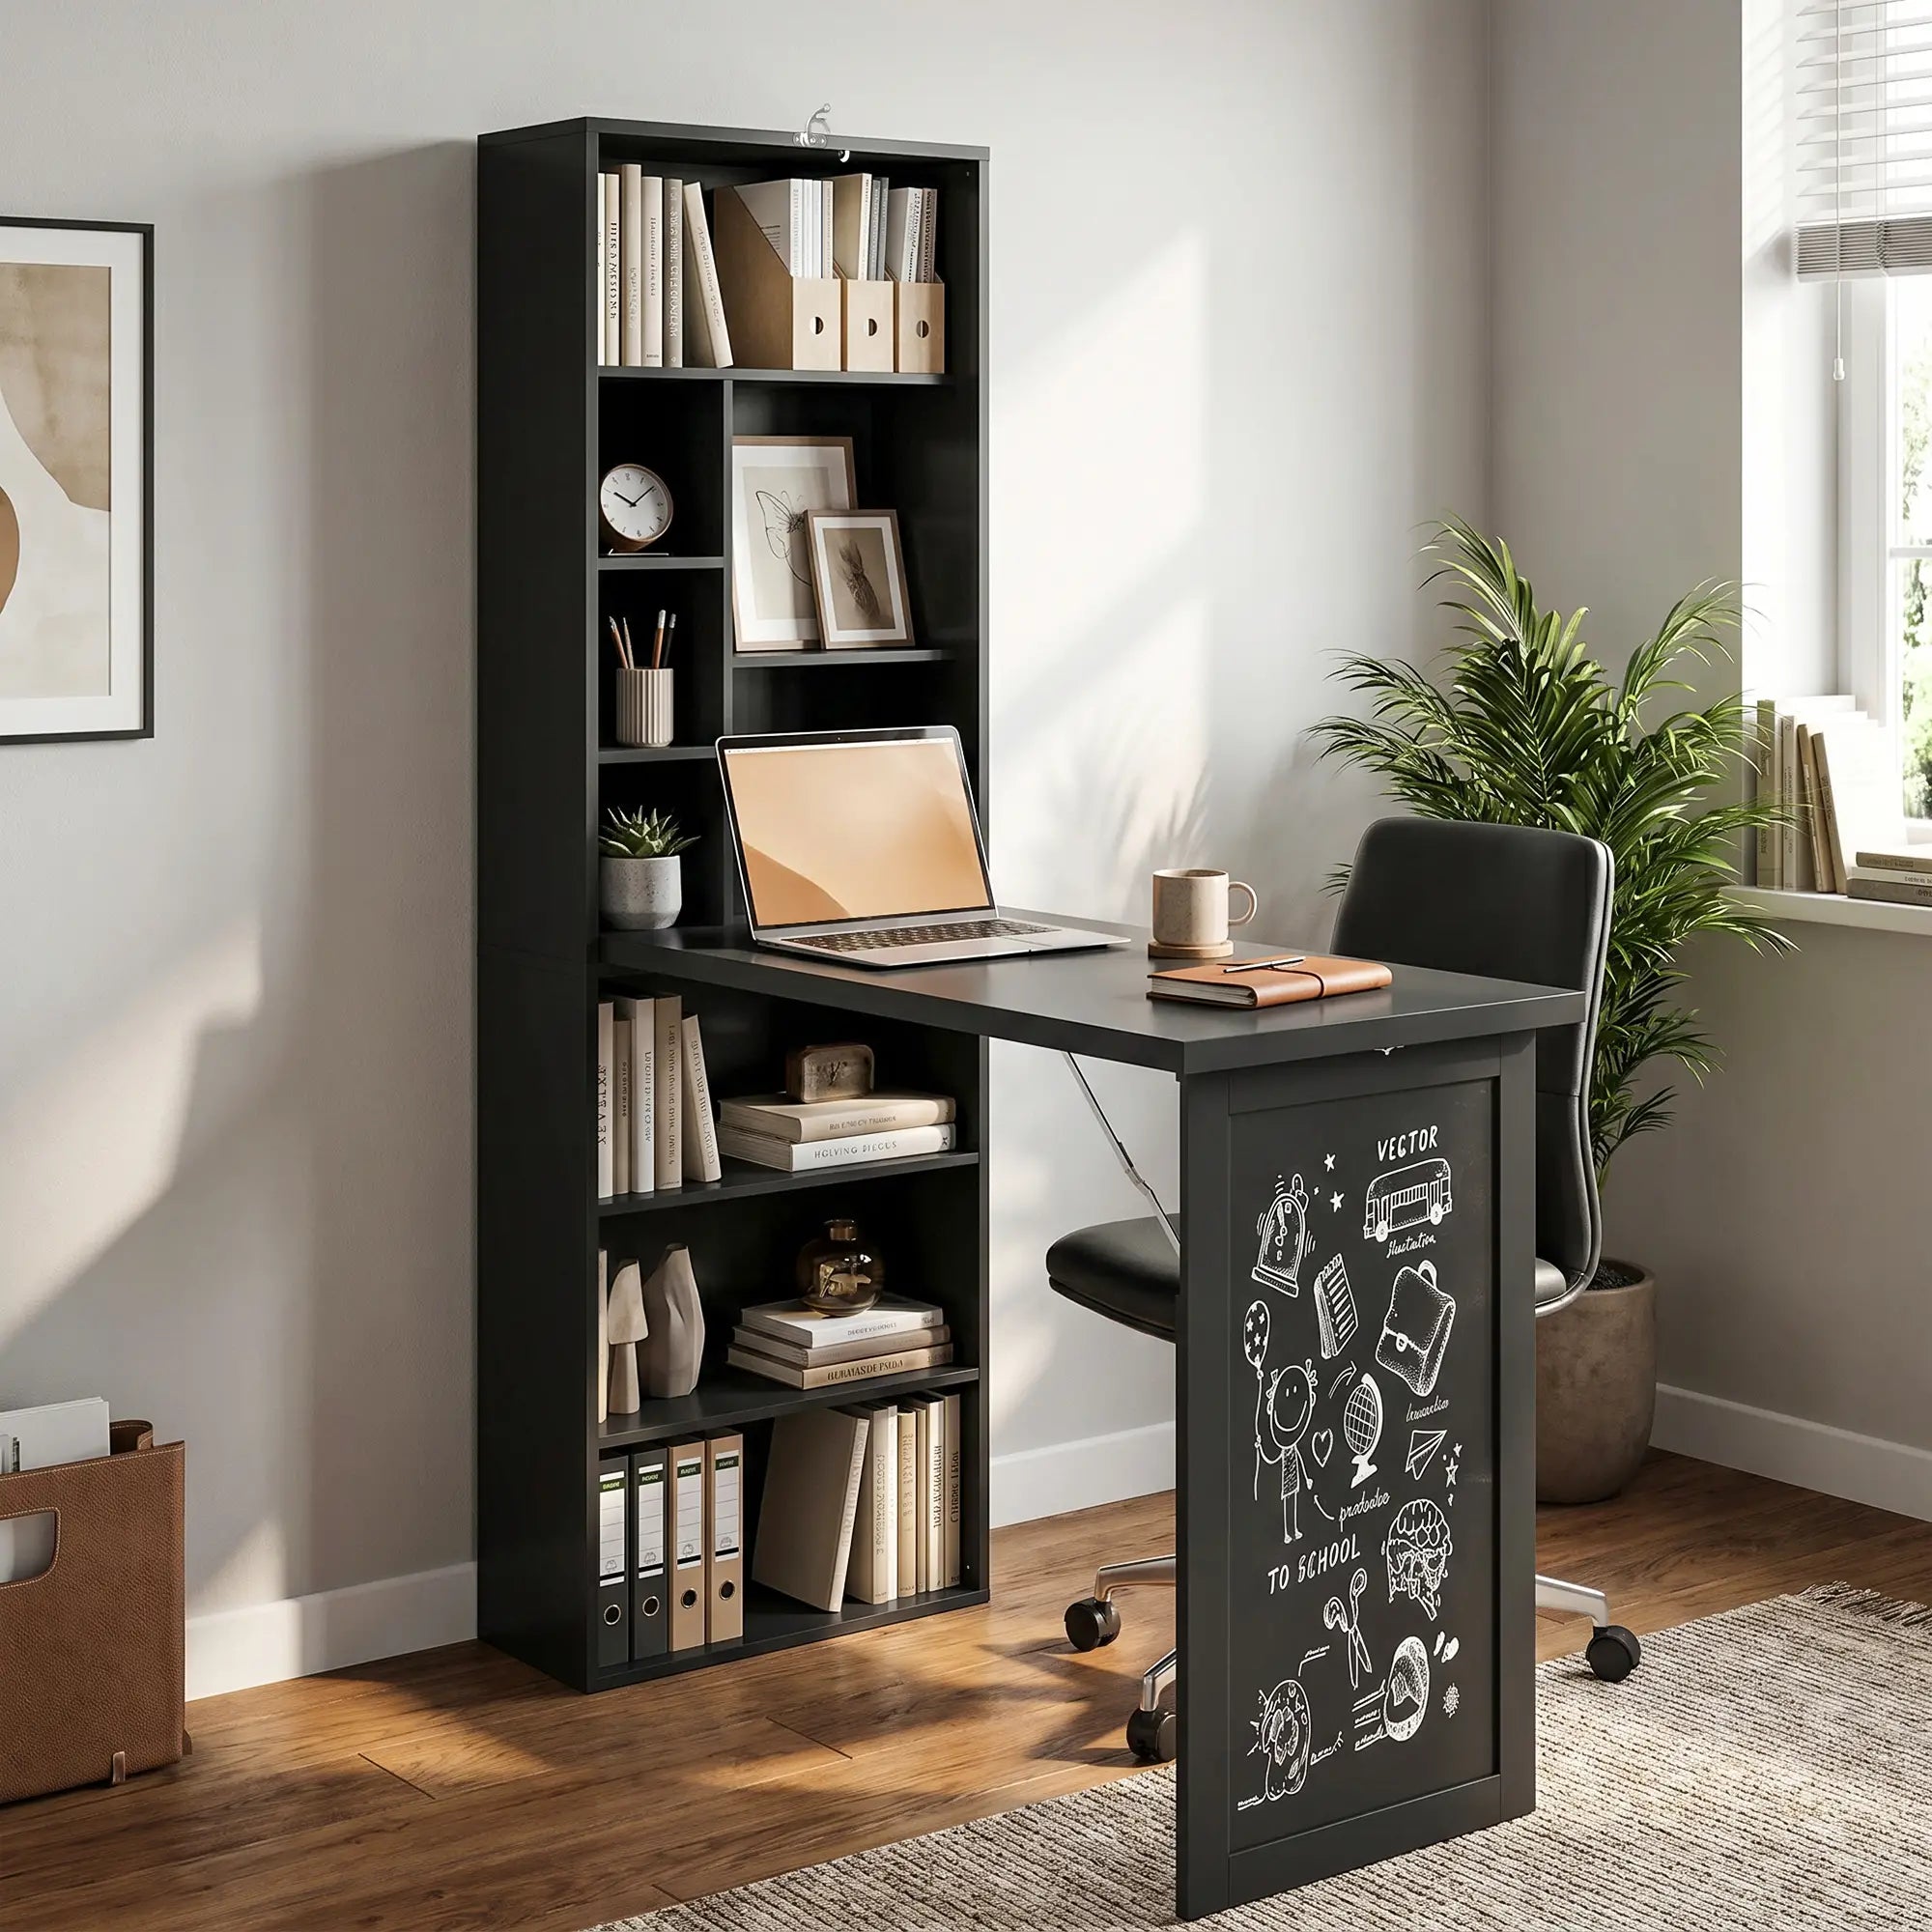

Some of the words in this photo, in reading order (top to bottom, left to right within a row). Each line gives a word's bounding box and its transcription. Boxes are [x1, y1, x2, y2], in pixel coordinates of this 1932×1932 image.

[1378, 1124, 1438, 1162] VECTOR
[1267, 1564, 1290, 1595] TO
[1297, 1533, 1361, 1583] SCHOOL
